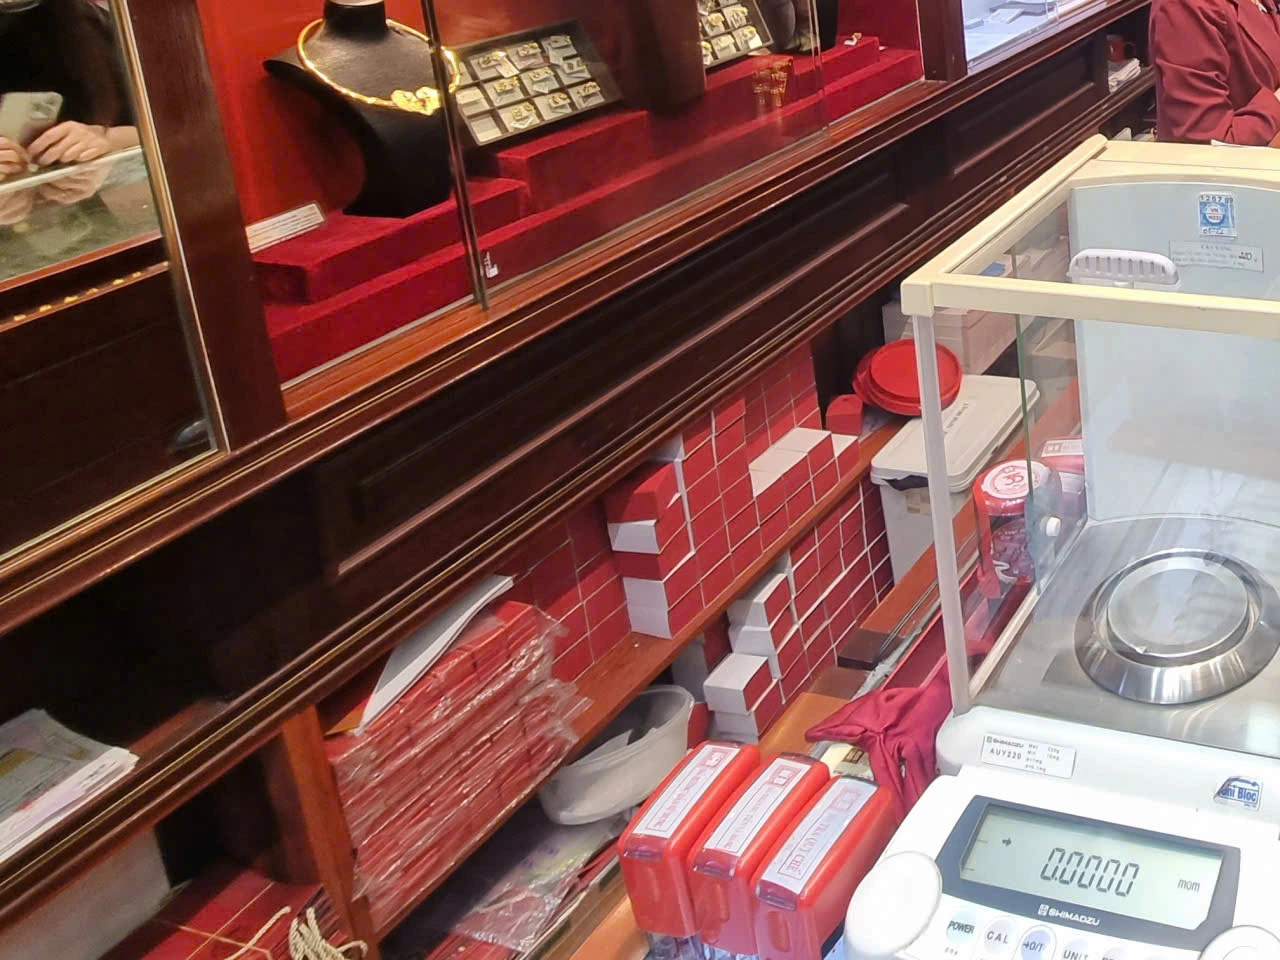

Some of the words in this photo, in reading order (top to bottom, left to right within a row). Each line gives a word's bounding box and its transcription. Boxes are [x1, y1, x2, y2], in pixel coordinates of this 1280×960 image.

[990, 748, 1022, 760] AUY220
[1238, 787, 1257, 802] Bloc
[1039, 847, 1140, 897] 0.0000
[1177, 878, 1200, 893] mom
[1048, 908, 1100, 926] SHIMADZU
[949, 919, 975, 936] POWER
[986, 930, 1009, 944] CAL
